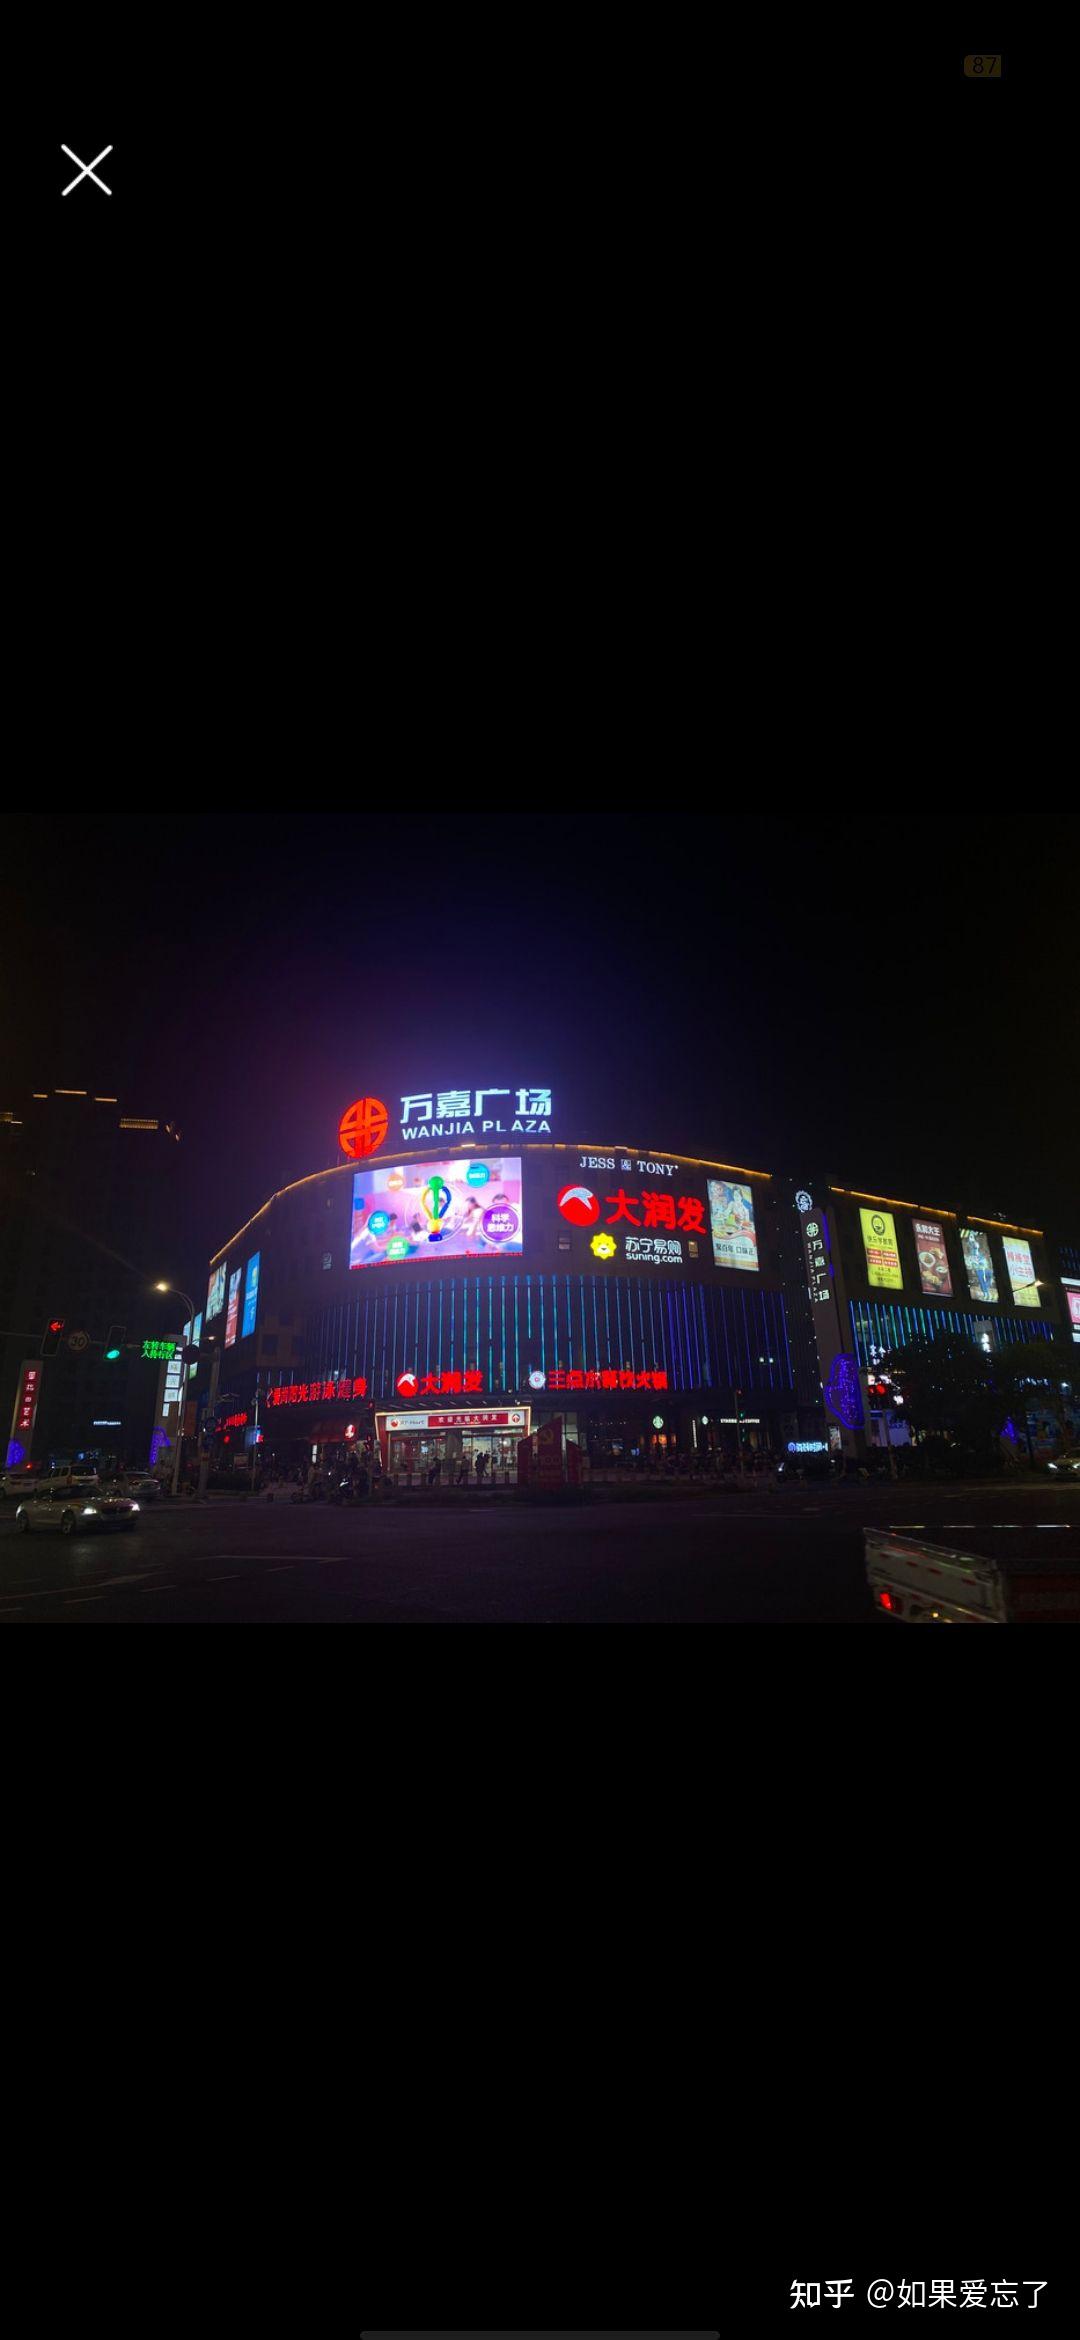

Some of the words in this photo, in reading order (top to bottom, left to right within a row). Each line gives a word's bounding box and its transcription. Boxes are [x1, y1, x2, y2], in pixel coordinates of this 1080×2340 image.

[400, 1088, 552, 1124] 万嘉广场
[402, 1121, 474, 1140] WANJIA
[482, 1120, 551, 1133] PLAZA
[580, 1157, 615, 1169] JESS
[637, 1161, 674, 1176] TONY
[605, 1189, 707, 1234] 大润发
[625, 1236, 682, 1255] 苏宁易购
[626, 1253, 683, 1265] suning.com
[420, 1370, 483, 1395] 大润发
